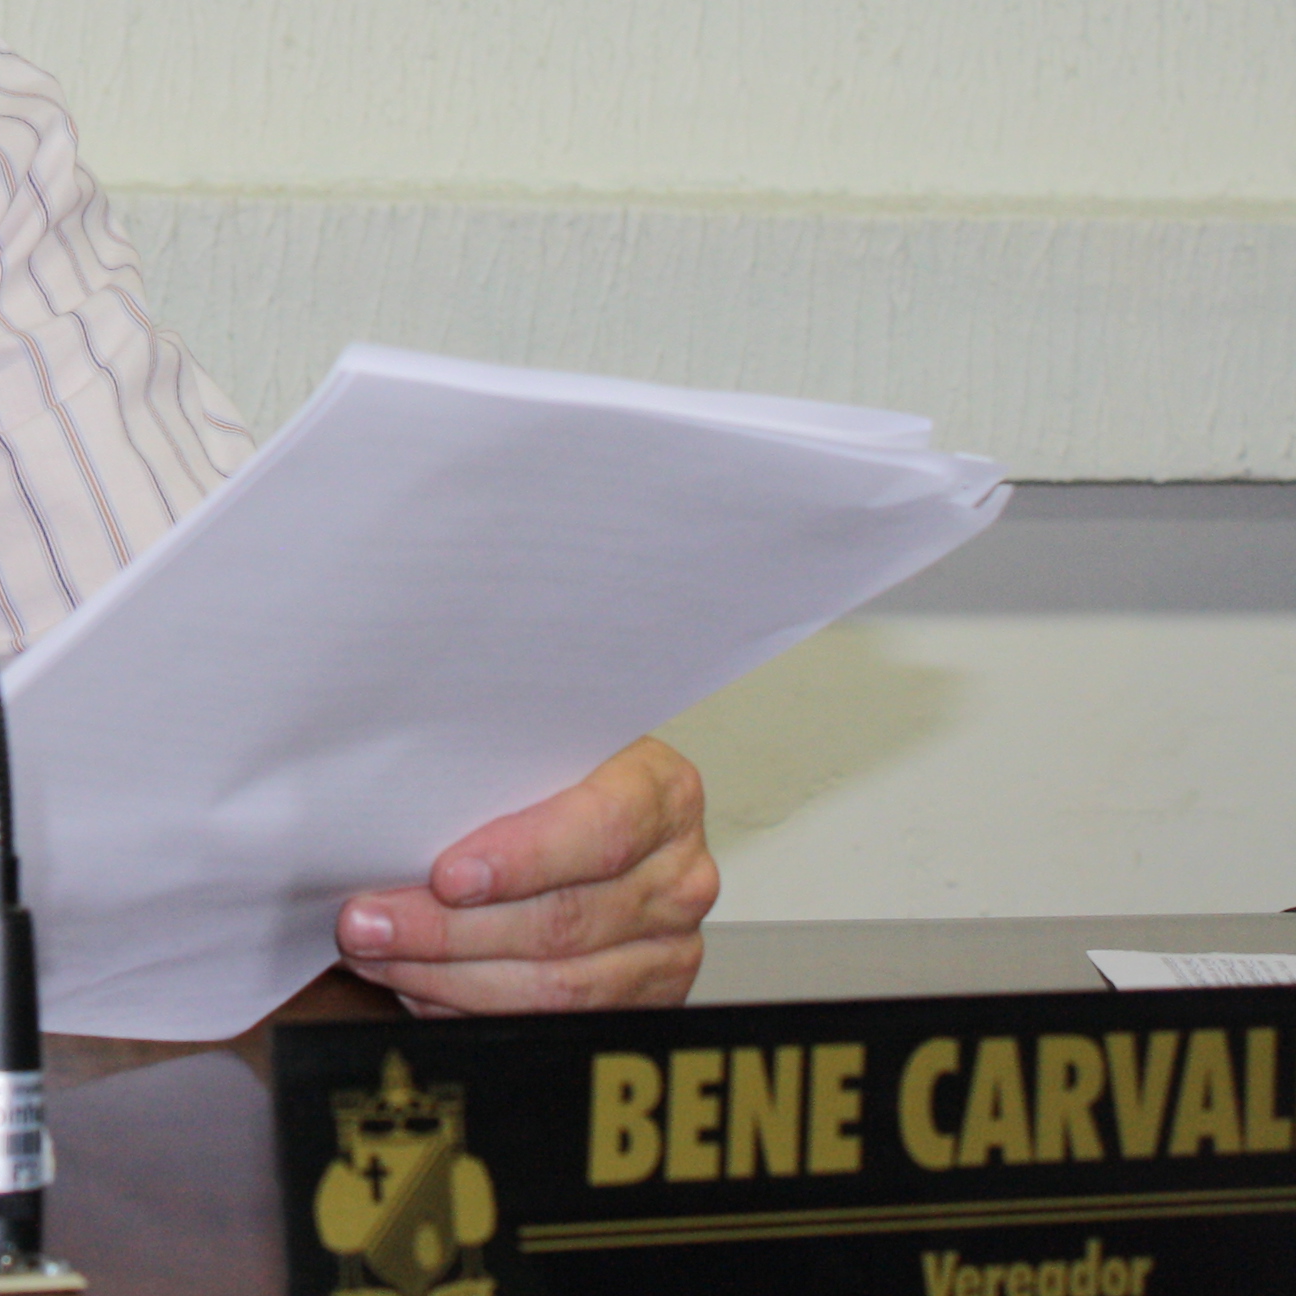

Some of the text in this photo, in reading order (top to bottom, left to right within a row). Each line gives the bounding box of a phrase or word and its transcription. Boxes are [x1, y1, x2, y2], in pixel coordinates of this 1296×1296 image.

[587, 1028, 1294, 1186] BENE CARVAL
[922, 1238, 1154, 1296] Vereador
